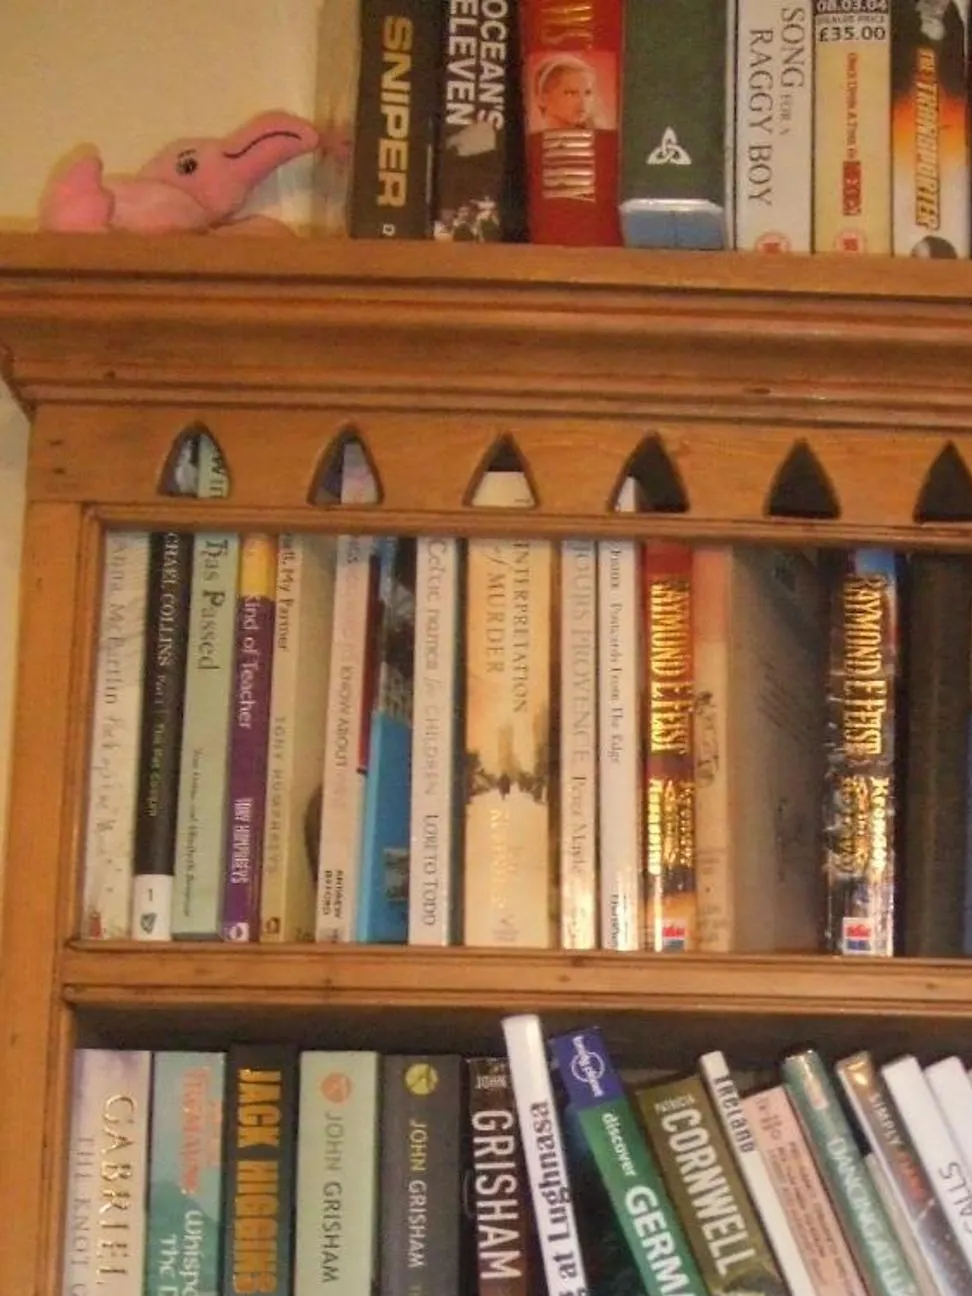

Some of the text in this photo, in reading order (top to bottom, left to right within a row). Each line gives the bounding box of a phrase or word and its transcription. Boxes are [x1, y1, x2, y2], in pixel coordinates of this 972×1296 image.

[446, 0, 478, 126] ELEVEN
[477, 0, 508, 130] OCEAN'S
[780, 8, 805, 88] SONG
[818, 25, 886, 41] £35.00
[376, 15, 413, 207] SNIPER
[748, 29, 773, 206] RAGGY BOY
[158, 592, 176, 667] COLLINS
[198, 591, 227, 671] Passed
[239, 594, 262, 730] Kind of Teacher
[486, 573, 506, 674] MURDER
[513, 543, 530, 714] INTERPRETATION
[844, 575, 889, 756] RAYMOND FEIST
[335, 666, 354, 767] KNOW ABOUT
[570, 630, 593, 764] PROVENCE
[651, 700, 692, 757] FEIST
[423, 815, 440, 926] LORETO TODD
[96, 1094, 137, 1283] GABRIEL
[232, 1068, 282, 1294] JACK HIGGINS
[324, 1110, 345, 1169] JOHN
[408, 1118, 429, 1267] JOHN GRISHAM
[472, 1110, 523, 1279] GRISHAM
[530, 1101, 571, 1243] Lughnasa
[602, 1112, 638, 1177] discover
[660, 1107, 757, 1276] CORNWELL
[823, 1134, 883, 1241] DANCING
[71, 1195, 92, 1267] KNOT
[321, 1180, 343, 1282] GRISHAM
[556, 1253, 578, 1281] at
